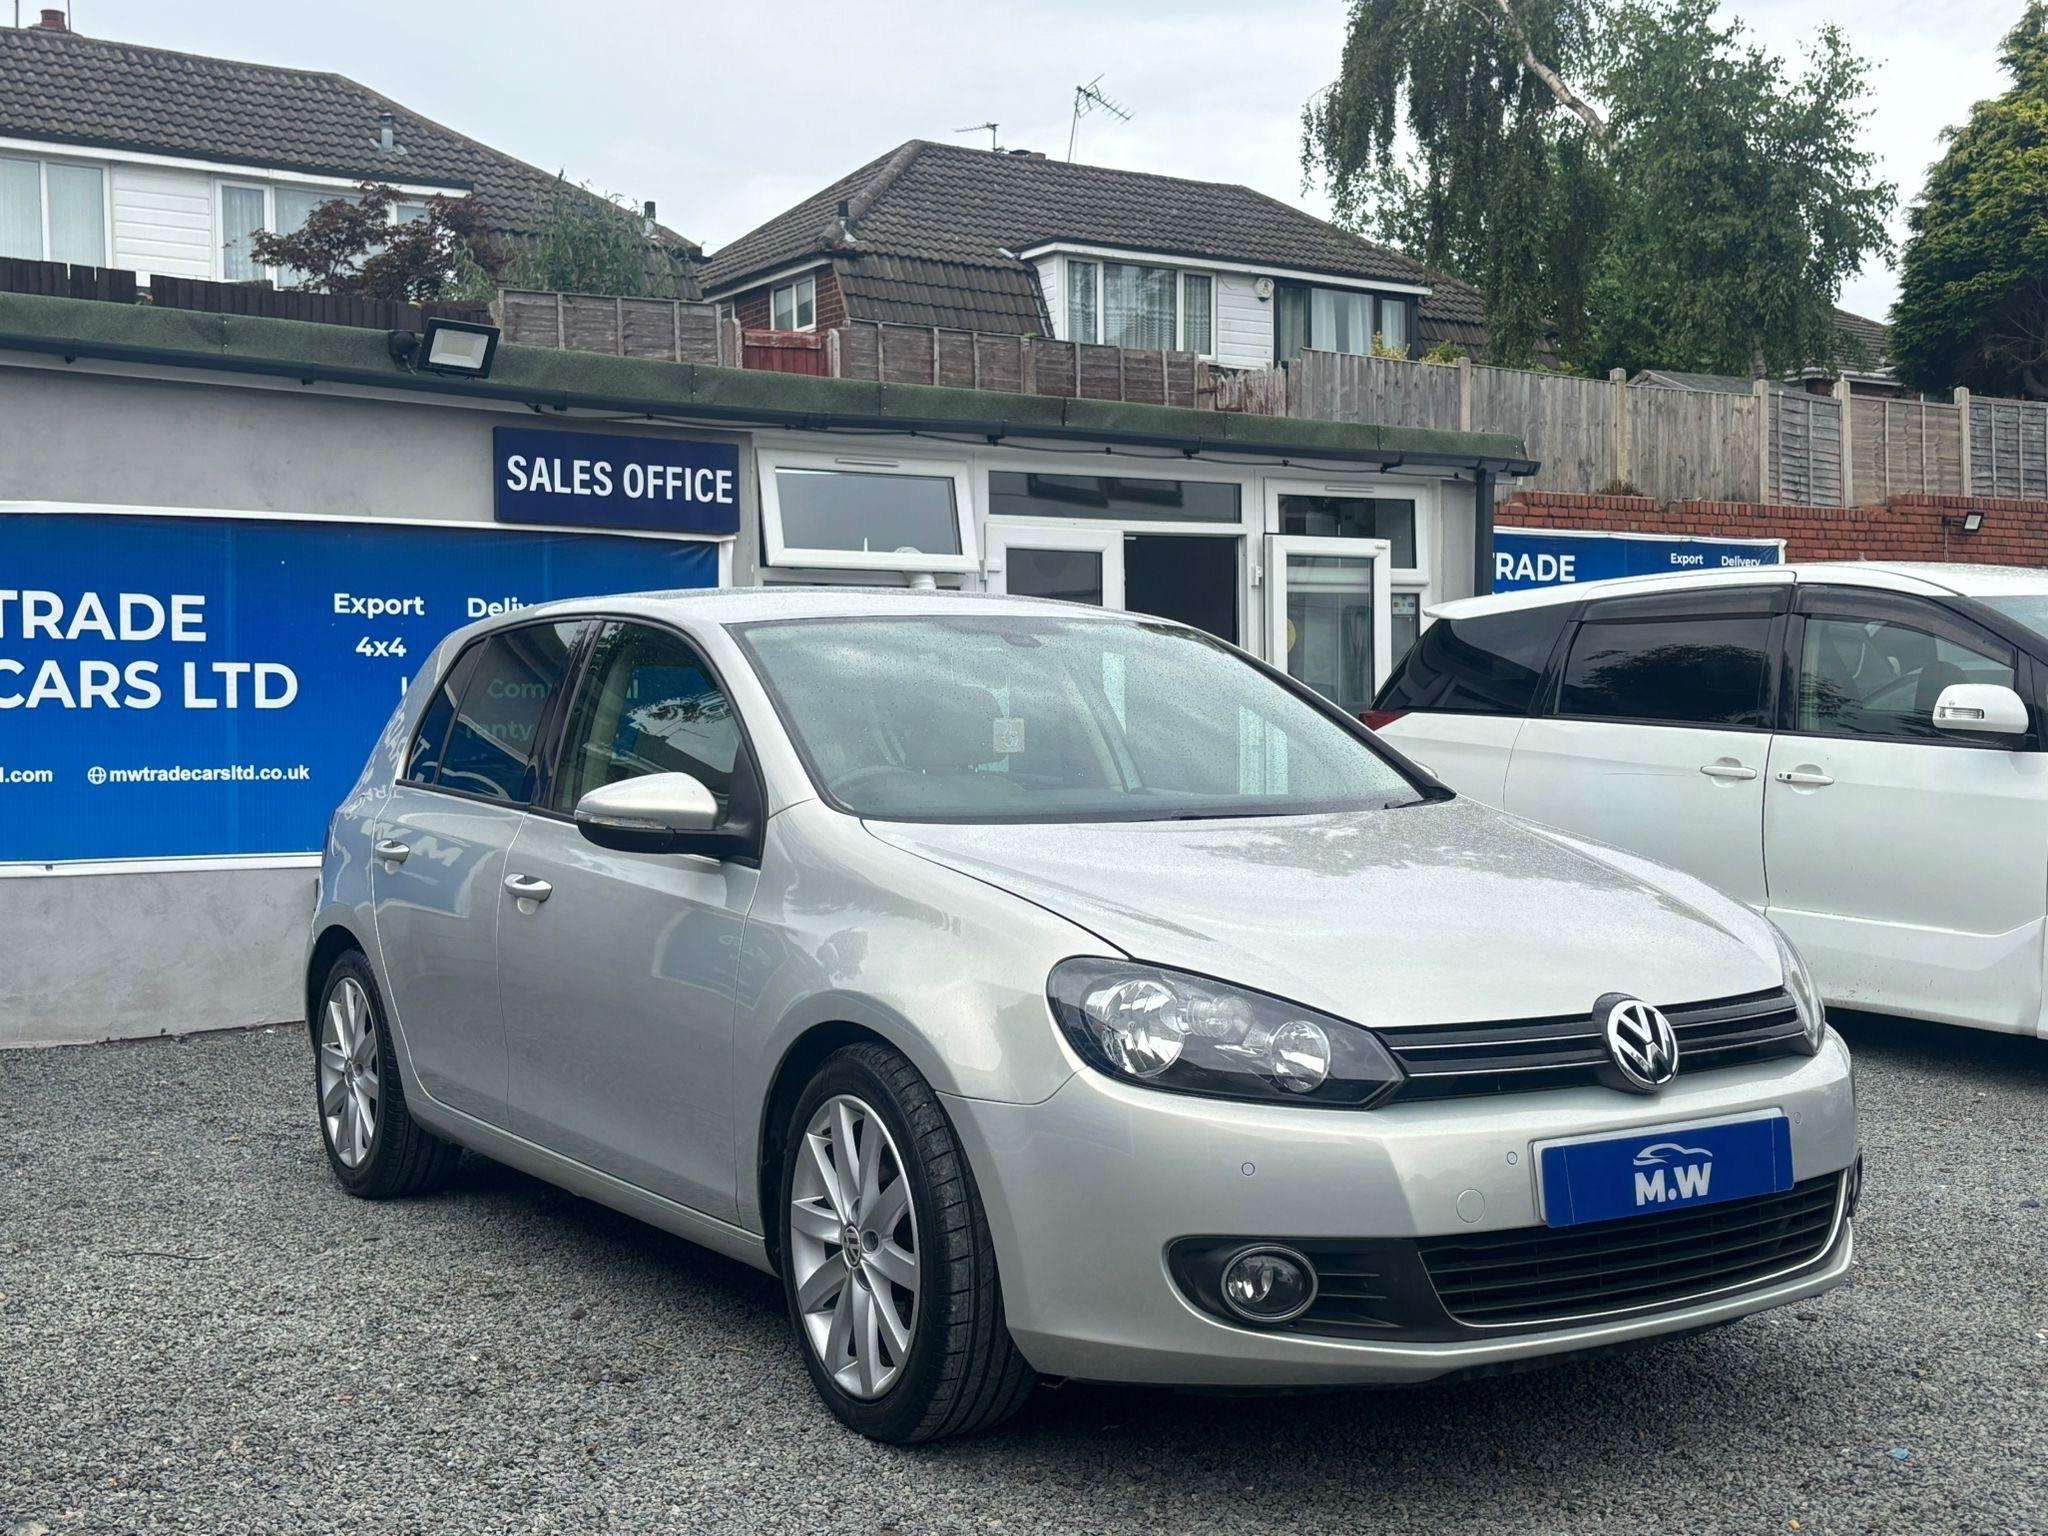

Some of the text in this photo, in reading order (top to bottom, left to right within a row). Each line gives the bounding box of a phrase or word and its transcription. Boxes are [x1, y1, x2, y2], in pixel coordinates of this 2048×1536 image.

[506, 454, 733, 504] SALES OFFICE
[1493, 552, 1576, 582] RADE
[1670, 552, 1704, 566] Export
[333, 592, 425, 619] Export
[355, 636, 407, 657] 4x4
[183, 661, 299, 709] LTD
[109, 764, 311, 782] mwtradecarsltd.co.uk
